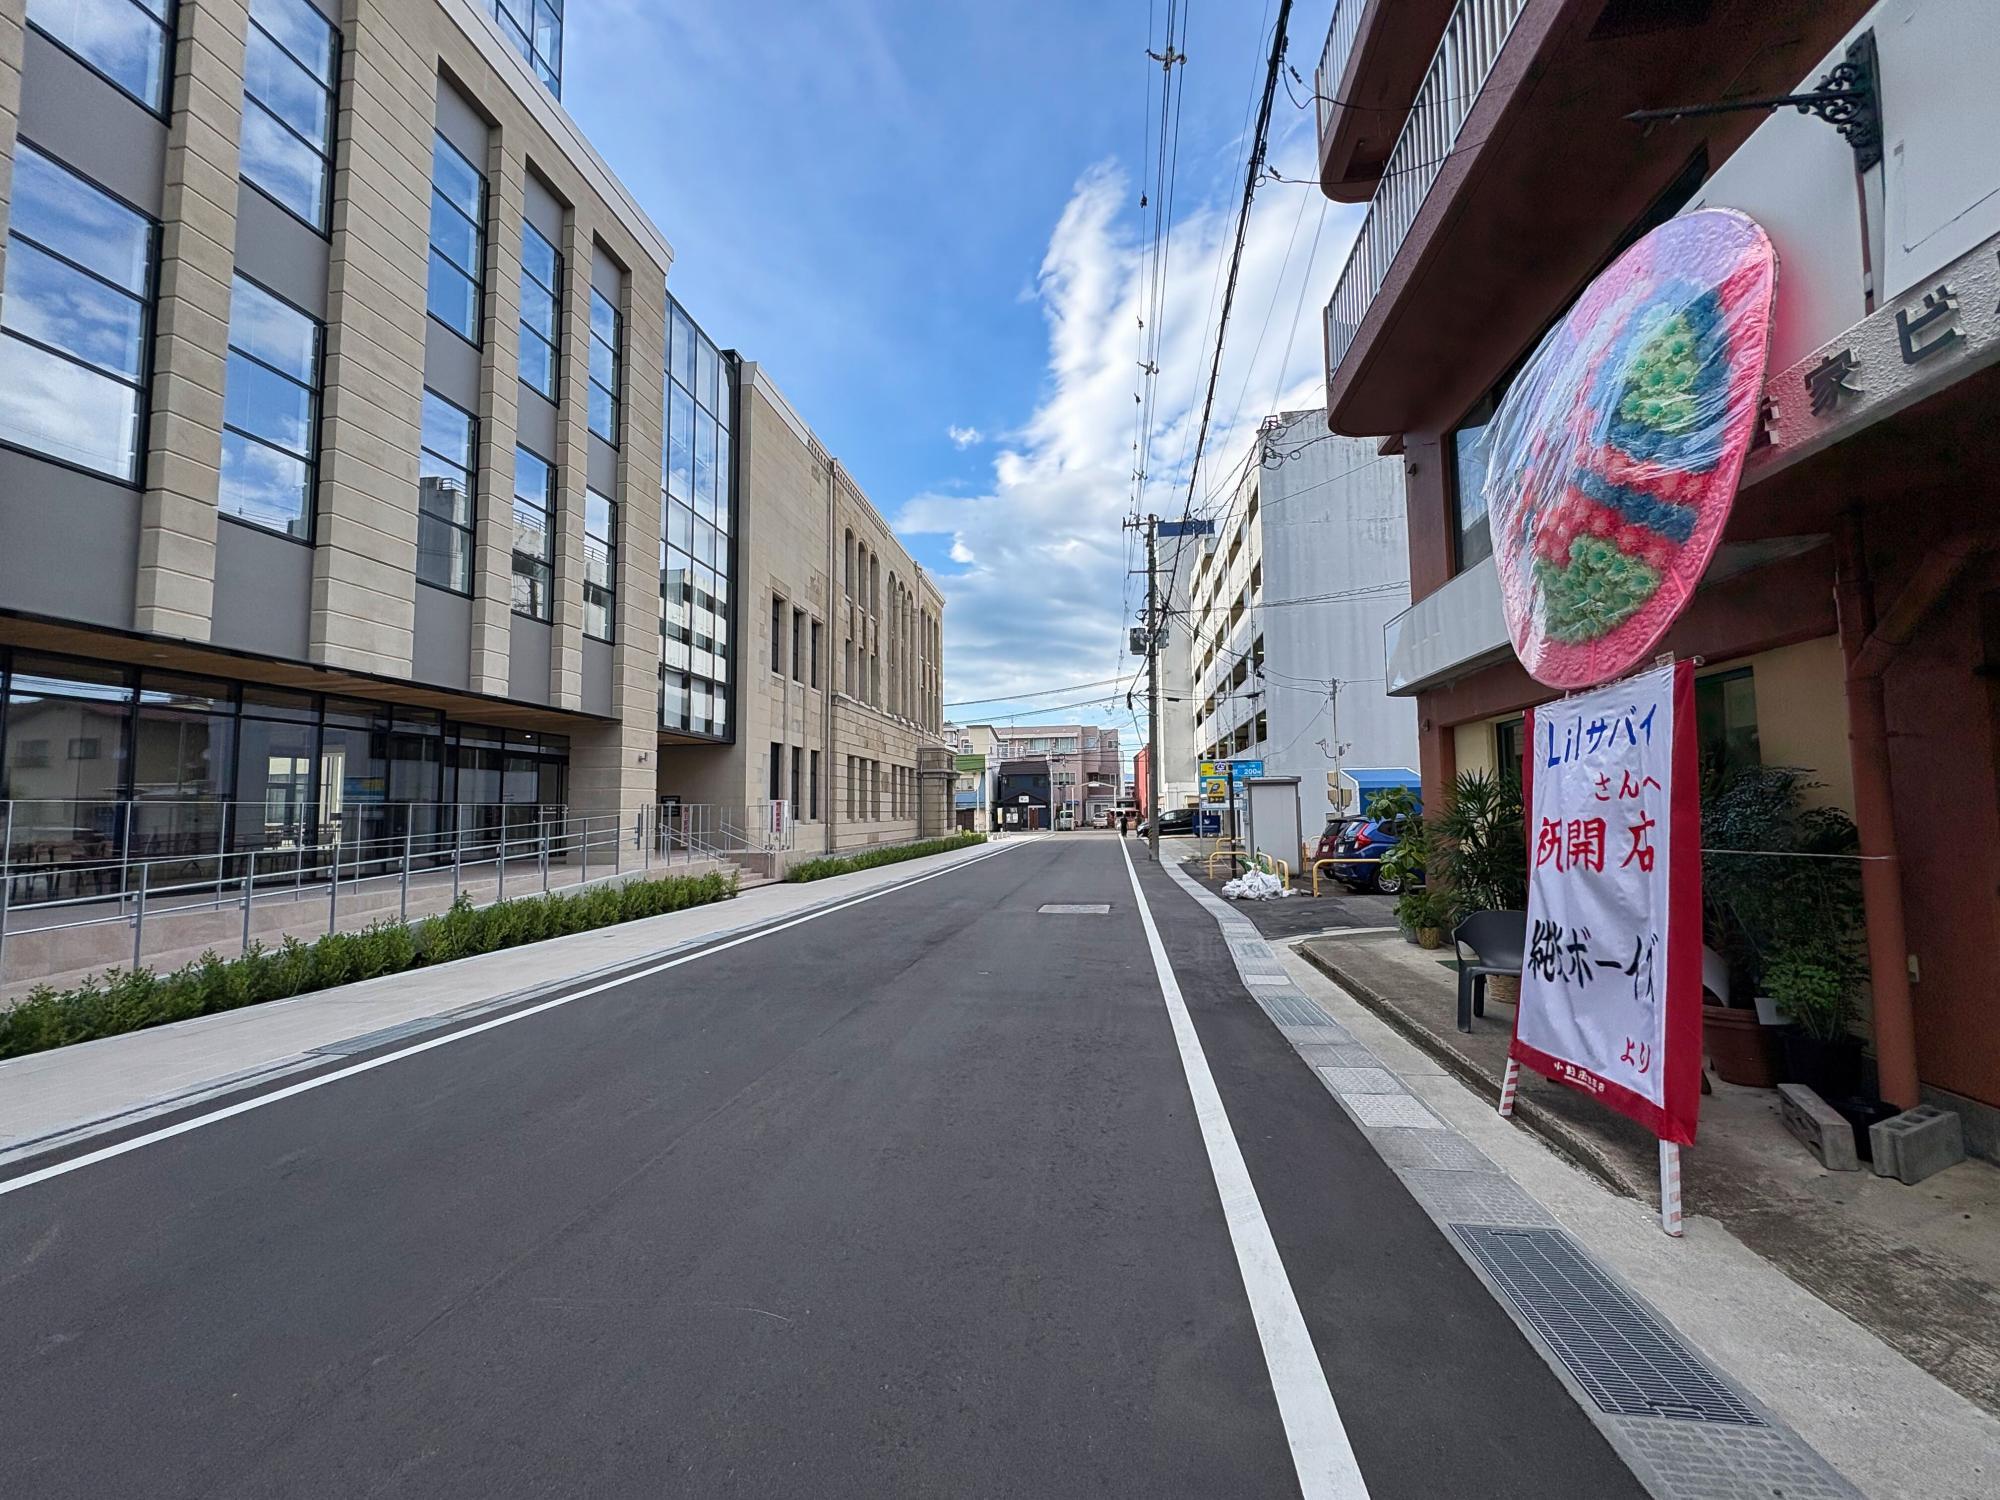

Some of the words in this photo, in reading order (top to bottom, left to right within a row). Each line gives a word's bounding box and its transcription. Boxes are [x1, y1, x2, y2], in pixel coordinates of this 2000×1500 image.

[1548, 703, 1657, 768] Lilサバイ
[1595, 769, 1661, 801] さんへ
[1620, 1037, 1651, 1074] より
